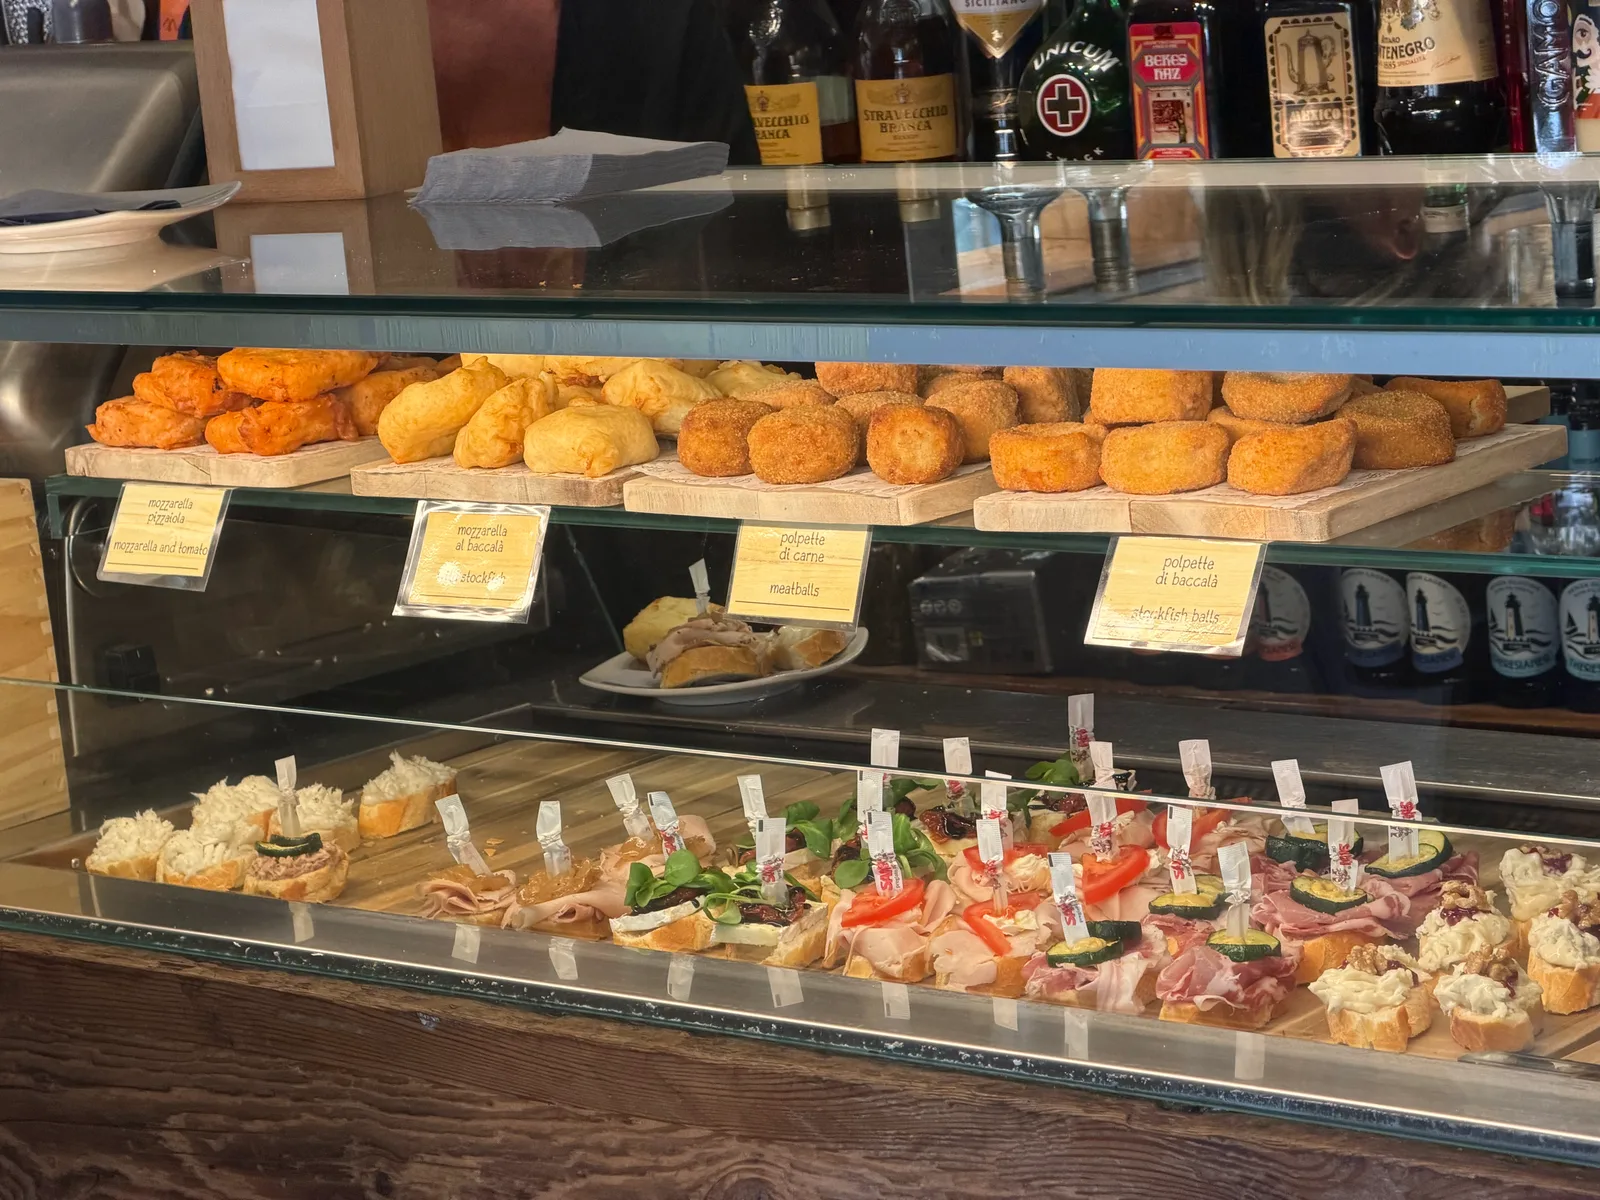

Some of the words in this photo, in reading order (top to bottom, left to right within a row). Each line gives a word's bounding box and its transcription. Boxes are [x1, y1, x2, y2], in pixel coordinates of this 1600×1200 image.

[1032, 40, 1120, 73] UNICUM
[863, 105, 949, 121] STRAVECCHIO
[879, 120, 933, 133] BRANCA
[148, 498, 193, 511] mozzarella
[147, 511, 186, 526] pizzaiola
[457, 524, 508, 539] mozzarella
[780, 530, 826, 548] polpette
[113, 540, 158, 554] mozzarella
[159, 541, 177, 554] and
[178, 541, 209, 556] tomato
[455, 538, 465, 551] al
[466, 538, 504, 553] baccalà
[779, 546, 791, 561] di
[793, 551, 825, 563] carne
[1162, 554, 1215, 572] polpette
[460, 570, 507, 585] stockfih
[1155, 571, 1169, 586] di
[1171, 572, 1219, 588] baccalà
[769, 581, 820, 597] meatballs
[1131, 605, 1188, 622] stockfish
[1191, 608, 1220, 624] balls
